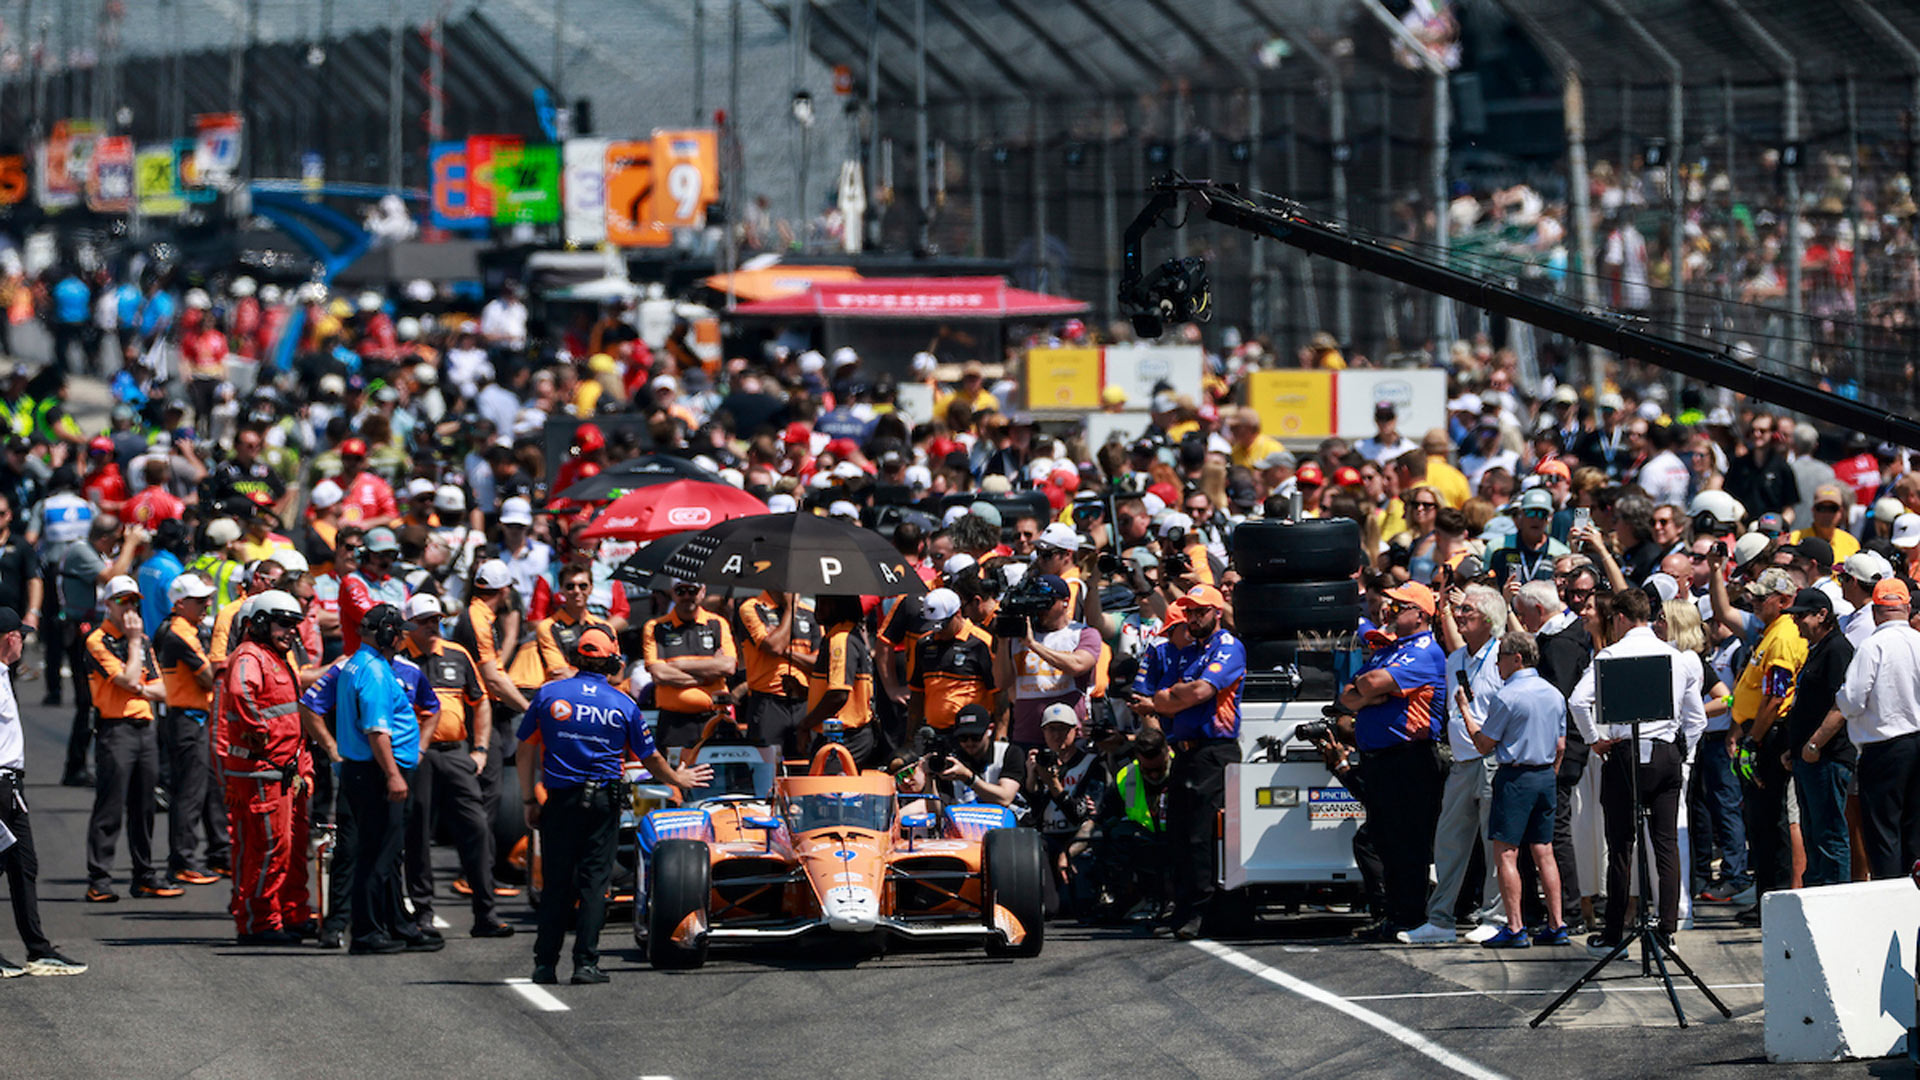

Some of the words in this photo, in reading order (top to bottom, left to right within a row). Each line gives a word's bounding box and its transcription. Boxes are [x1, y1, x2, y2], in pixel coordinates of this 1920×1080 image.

[668, 164, 701, 219] 9
[721, 555, 742, 574] A
[820, 556, 842, 585] P
[879, 562, 899, 583] A
[576, 704, 623, 728] PNC
